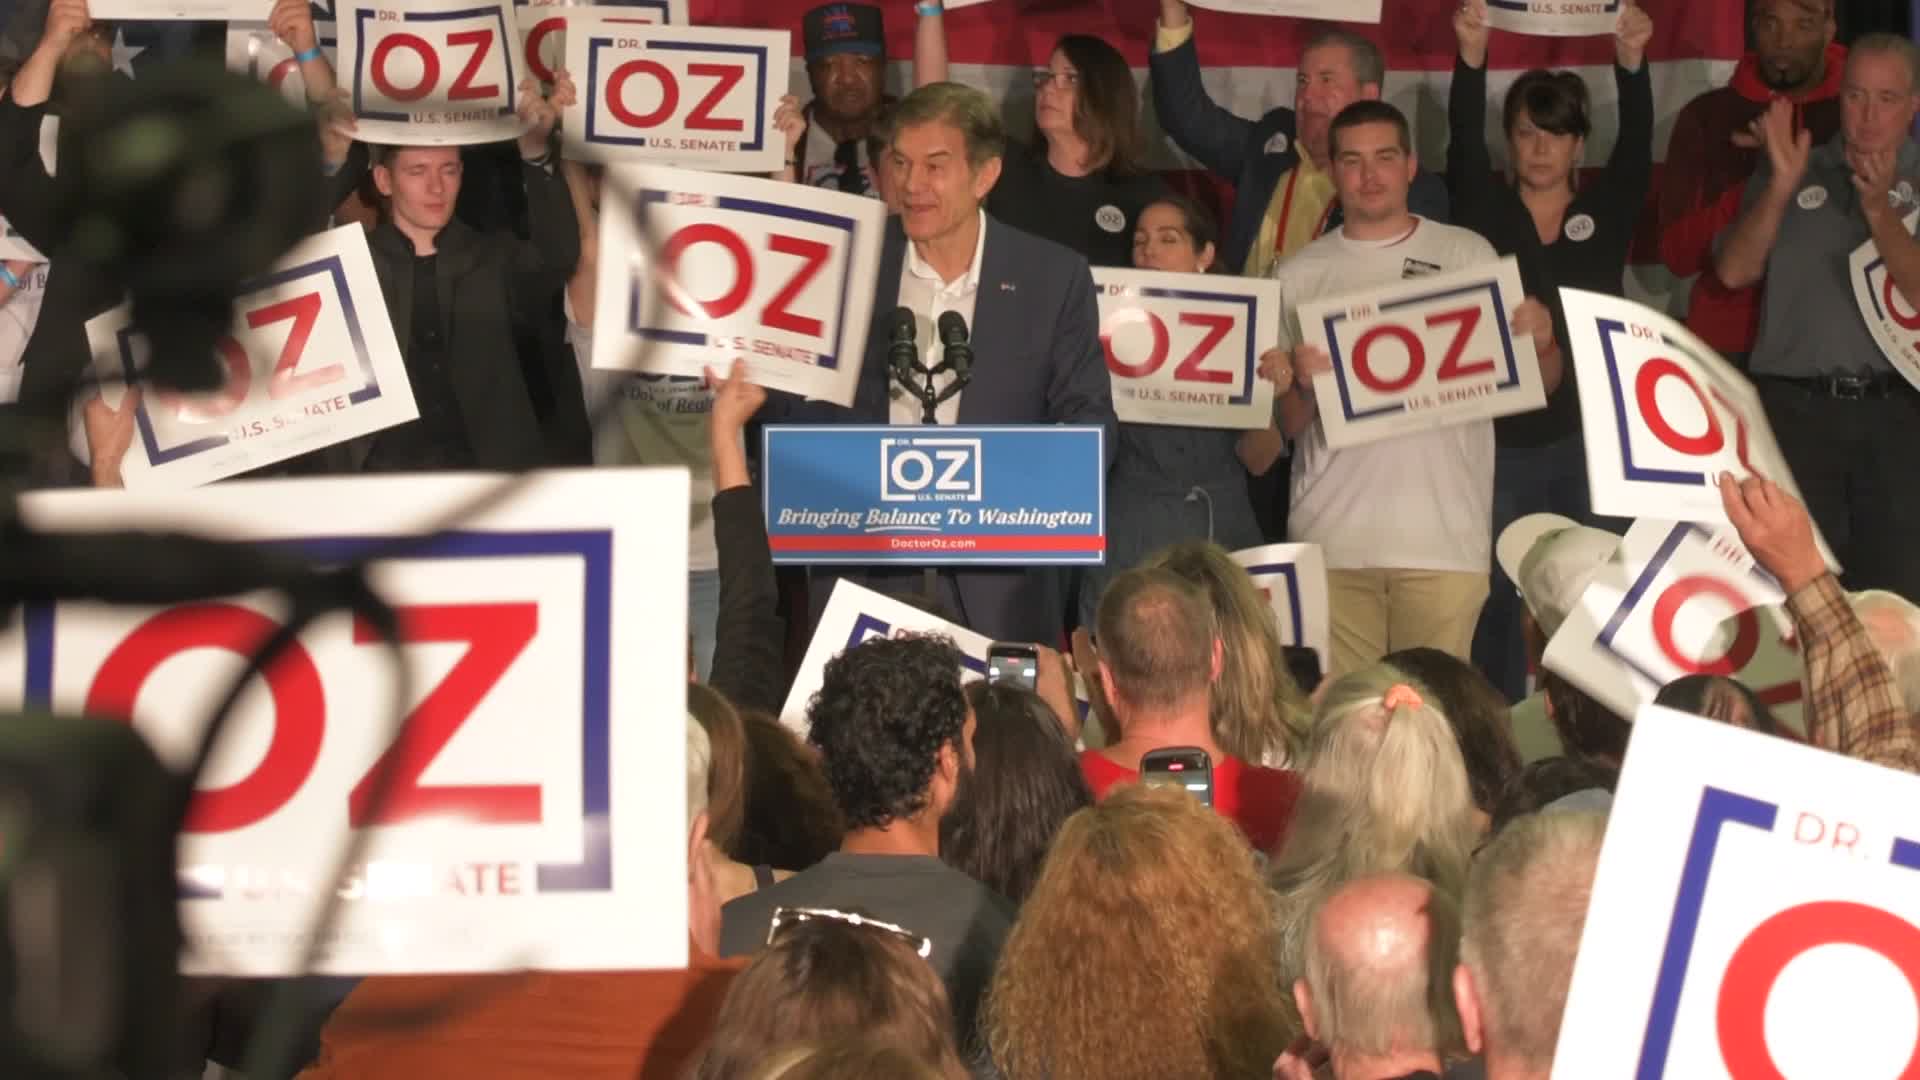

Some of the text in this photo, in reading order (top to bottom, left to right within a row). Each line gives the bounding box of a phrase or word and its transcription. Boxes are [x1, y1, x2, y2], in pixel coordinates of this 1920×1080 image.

[378, 10, 400, 21] DR.
[1560, 3, 1602, 15] SENATE
[617, 38, 642, 50] DR.
[370, 28, 499, 102] OZ
[605, 59, 744, 132] OZ
[413, 108, 497, 124] U.S. SENATE
[649, 137, 737, 152] U.S. SENATE
[661, 222, 833, 339] OZ
[1099, 308, 1235, 384] OZ
[1351, 304, 1497, 395] OZ
[1138, 387, 1226, 406] U.S. SENATE
[1408, 382, 1494, 411] U.S. SENATE
[891, 449, 971, 490] OZ
[777, 507, 1093, 530] Bringing Balance To Washington
[891, 538, 976, 550] DoctorOz.com
[84, 601, 542, 834] OZ
